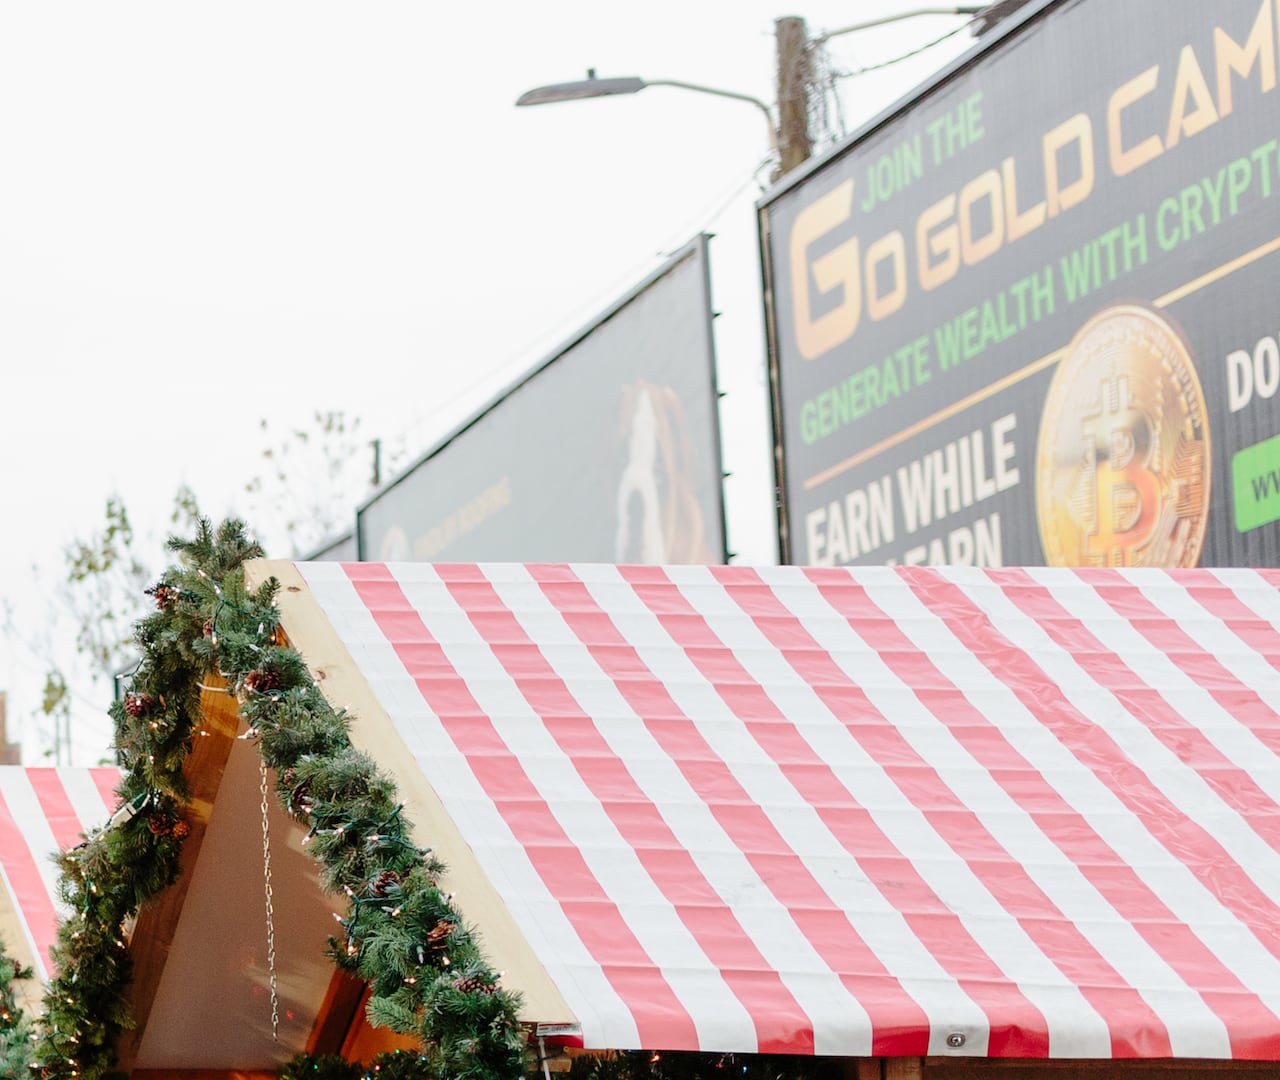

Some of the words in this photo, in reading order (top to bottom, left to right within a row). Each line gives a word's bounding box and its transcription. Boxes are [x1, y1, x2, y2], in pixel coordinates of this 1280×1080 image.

[861, 132, 923, 213] JOIN
[926, 91, 986, 167] THE
[916, 113, 1095, 291] GOLD
[1107, 0, 1280, 176] CAM
[800, 335, 932, 445] GENERATE
[934, 264, 1056, 372] WEALTH
[1060, 212, 1148, 303] WITH
[1156, 138, 1280, 251] CRYPT
[1226, 330, 1280, 413] DO
[805, 475, 895, 566] EARN
[896, 412, 1020, 534] WHILE
